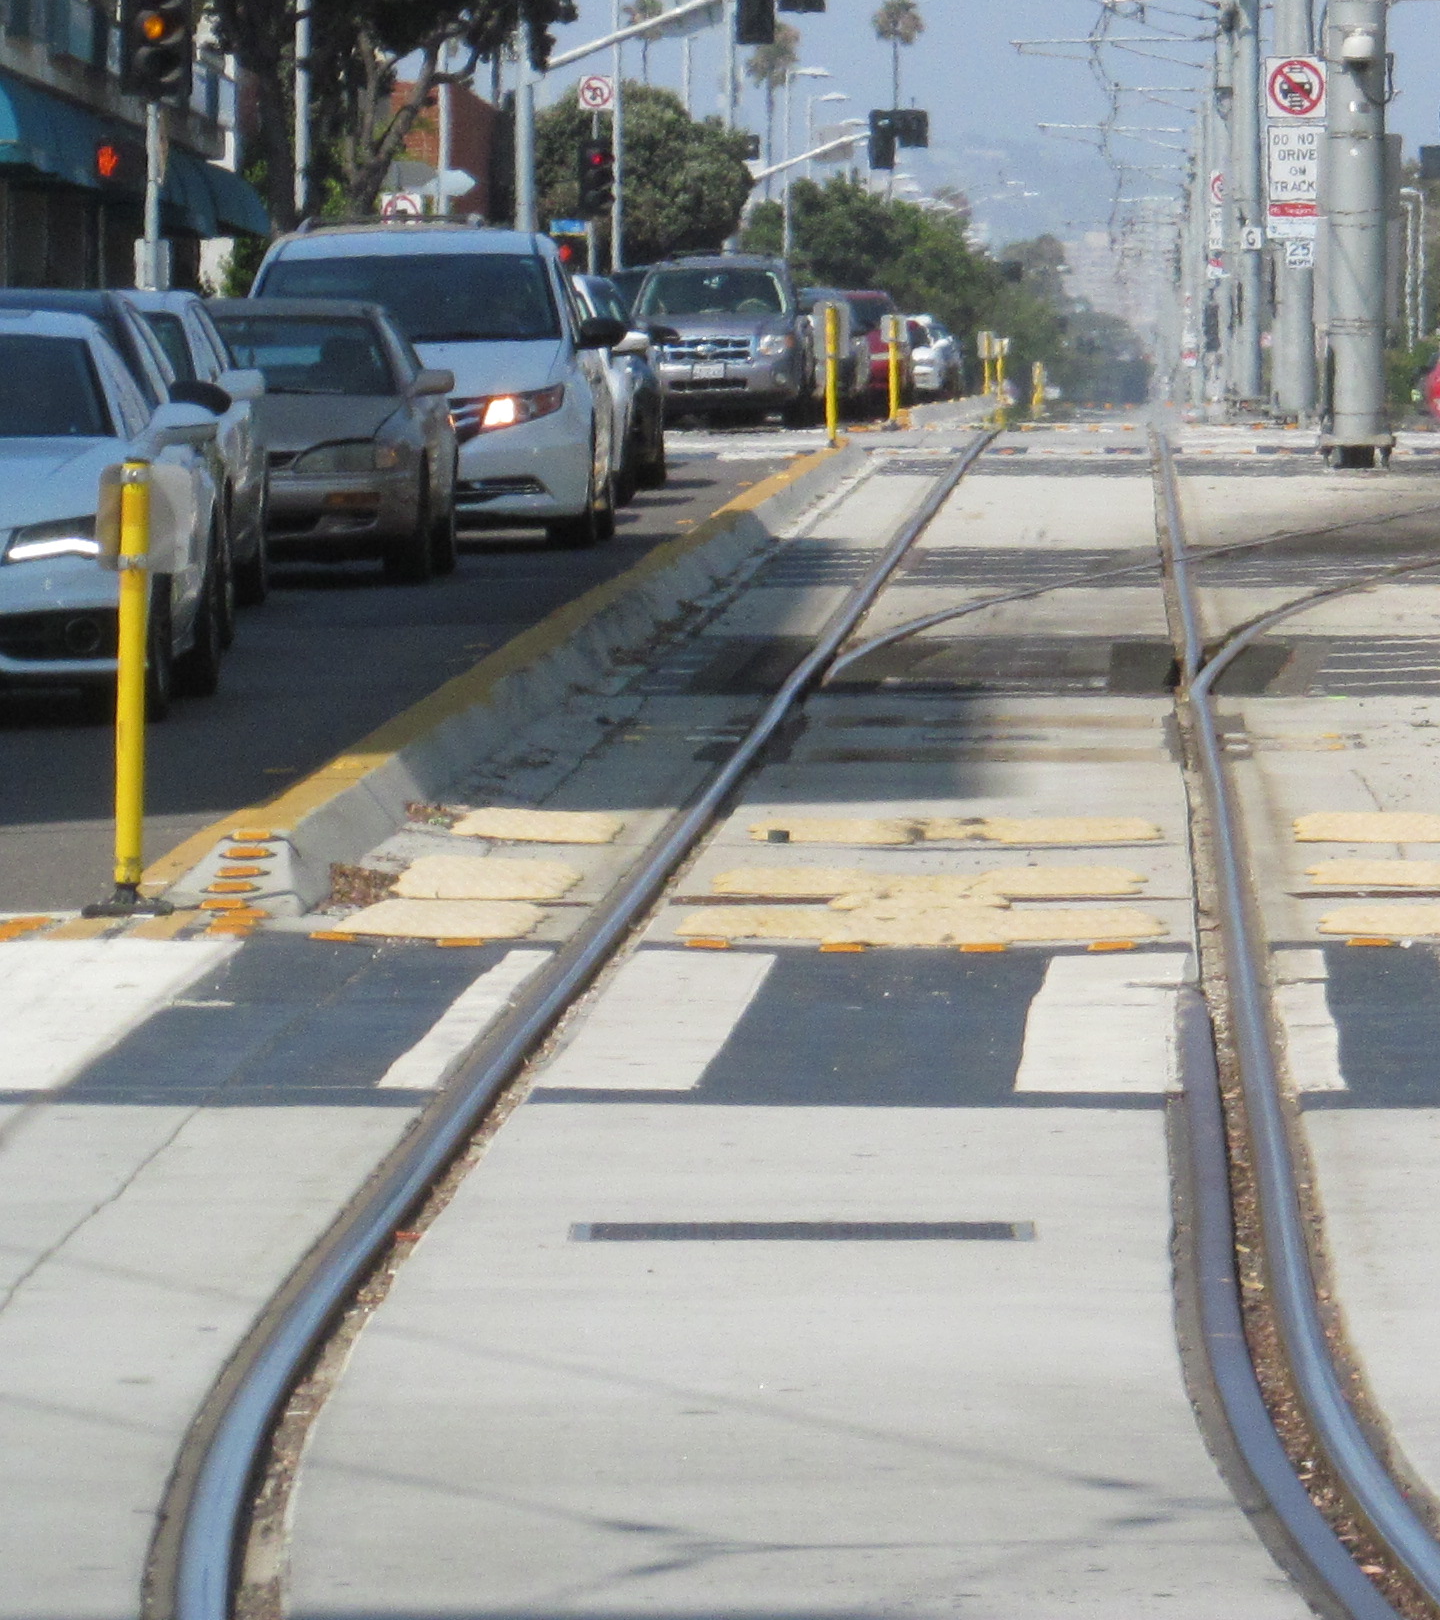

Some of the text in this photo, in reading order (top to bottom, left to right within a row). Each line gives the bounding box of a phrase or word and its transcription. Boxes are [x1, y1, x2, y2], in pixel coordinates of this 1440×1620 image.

[1273, 133, 1315, 146] DO NO
[1278, 149, 1317, 161] DRIVE
[1274, 181, 1316, 193] TRACK
[1289, 243, 1310, 257] 25
